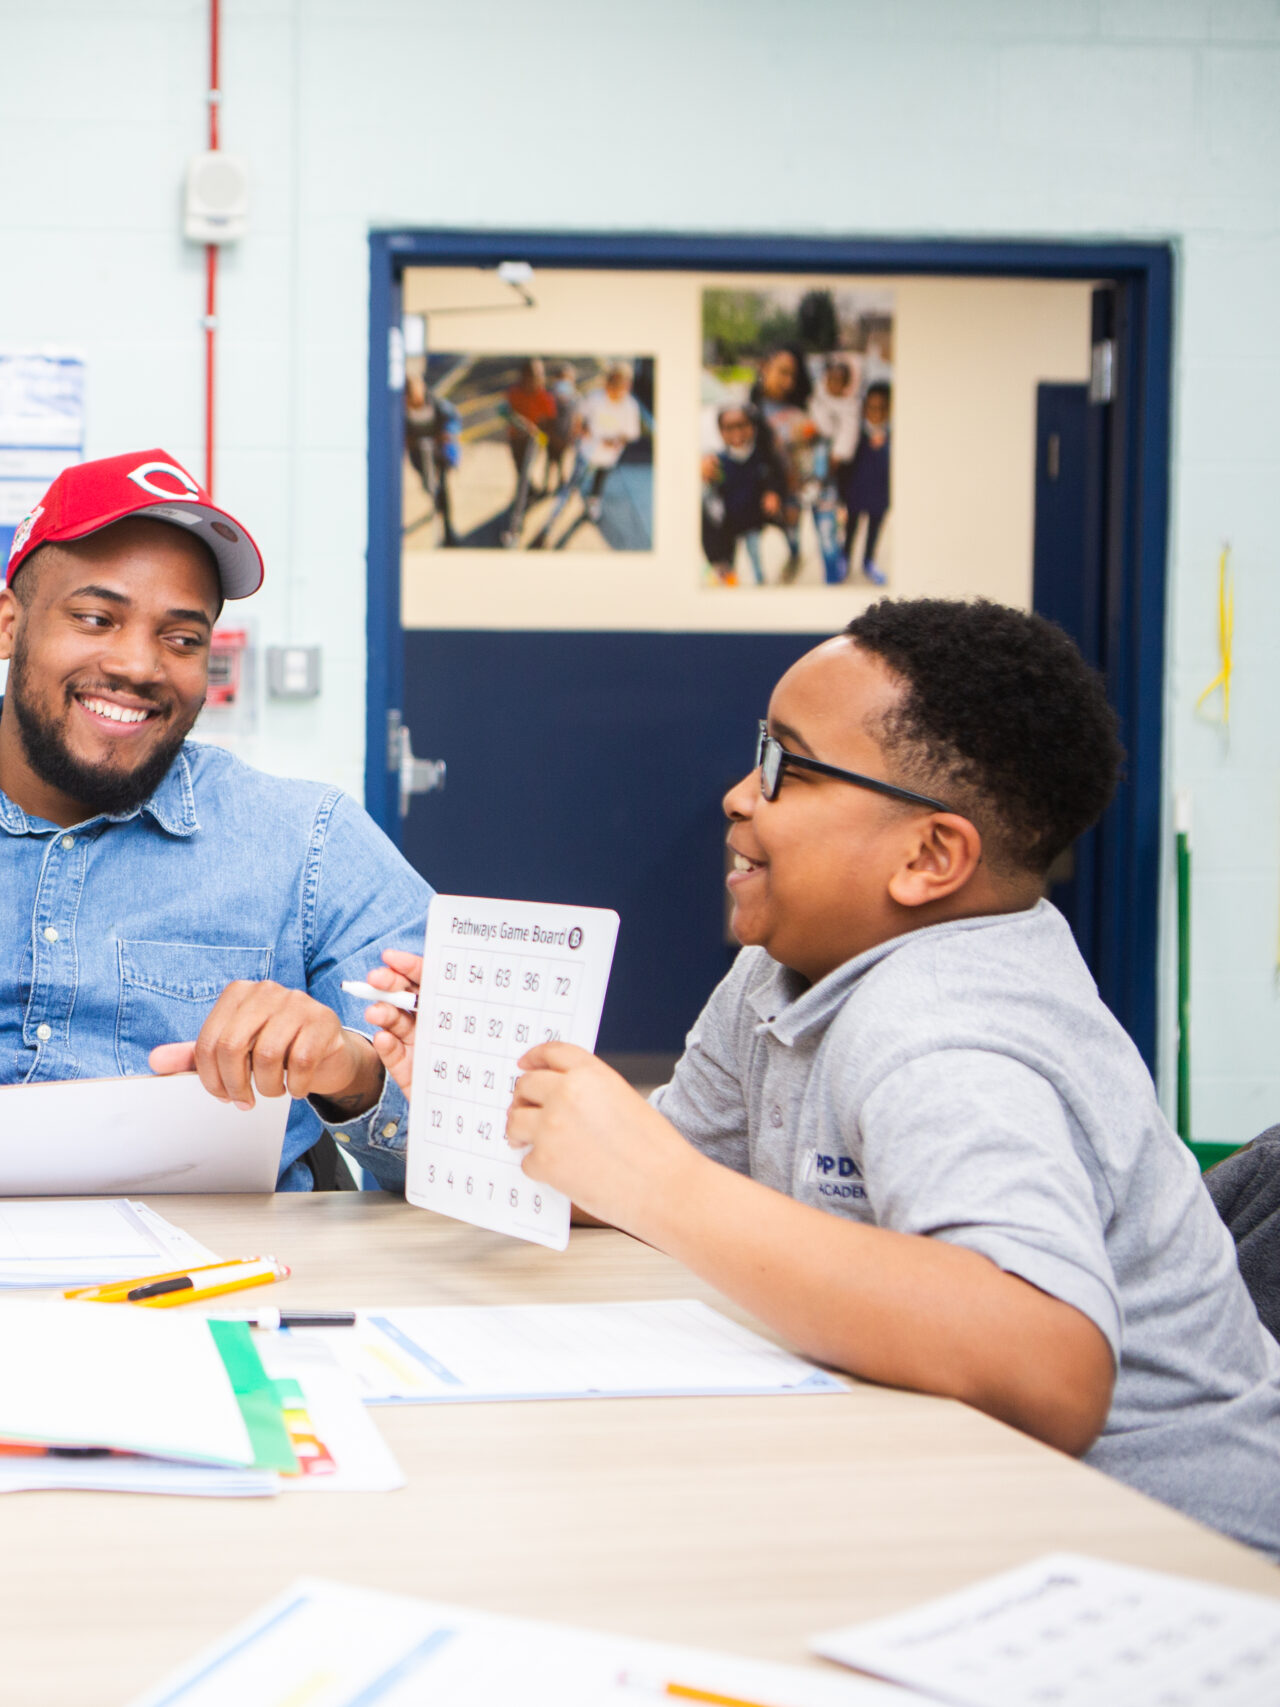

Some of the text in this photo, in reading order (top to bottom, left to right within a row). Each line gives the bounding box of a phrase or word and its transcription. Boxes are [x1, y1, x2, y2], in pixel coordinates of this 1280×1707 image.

[127, 461, 200, 502] C
[451, 917, 497, 941] Pathways
[499, 922, 530, 942] Game
[532, 925, 567, 946] Board
[445, 962, 571, 997] 81 54 63 36 72
[438, 1011, 453, 1031] 28
[464, 1016, 476, 1035] 18
[487, 1018, 503, 1039] 32
[515, 1023, 530, 1044] 81
[433, 1060, 448, 1080] 48
[458, 1064, 472, 1085] 64
[484, 1069, 495, 1090] 21
[431, 1109, 443, 1128] 12
[457, 1115, 464, 1135] 9
[477, 1120, 493, 1141] 42
[428, 1164, 542, 1215] 3 4 6 7 8 9
